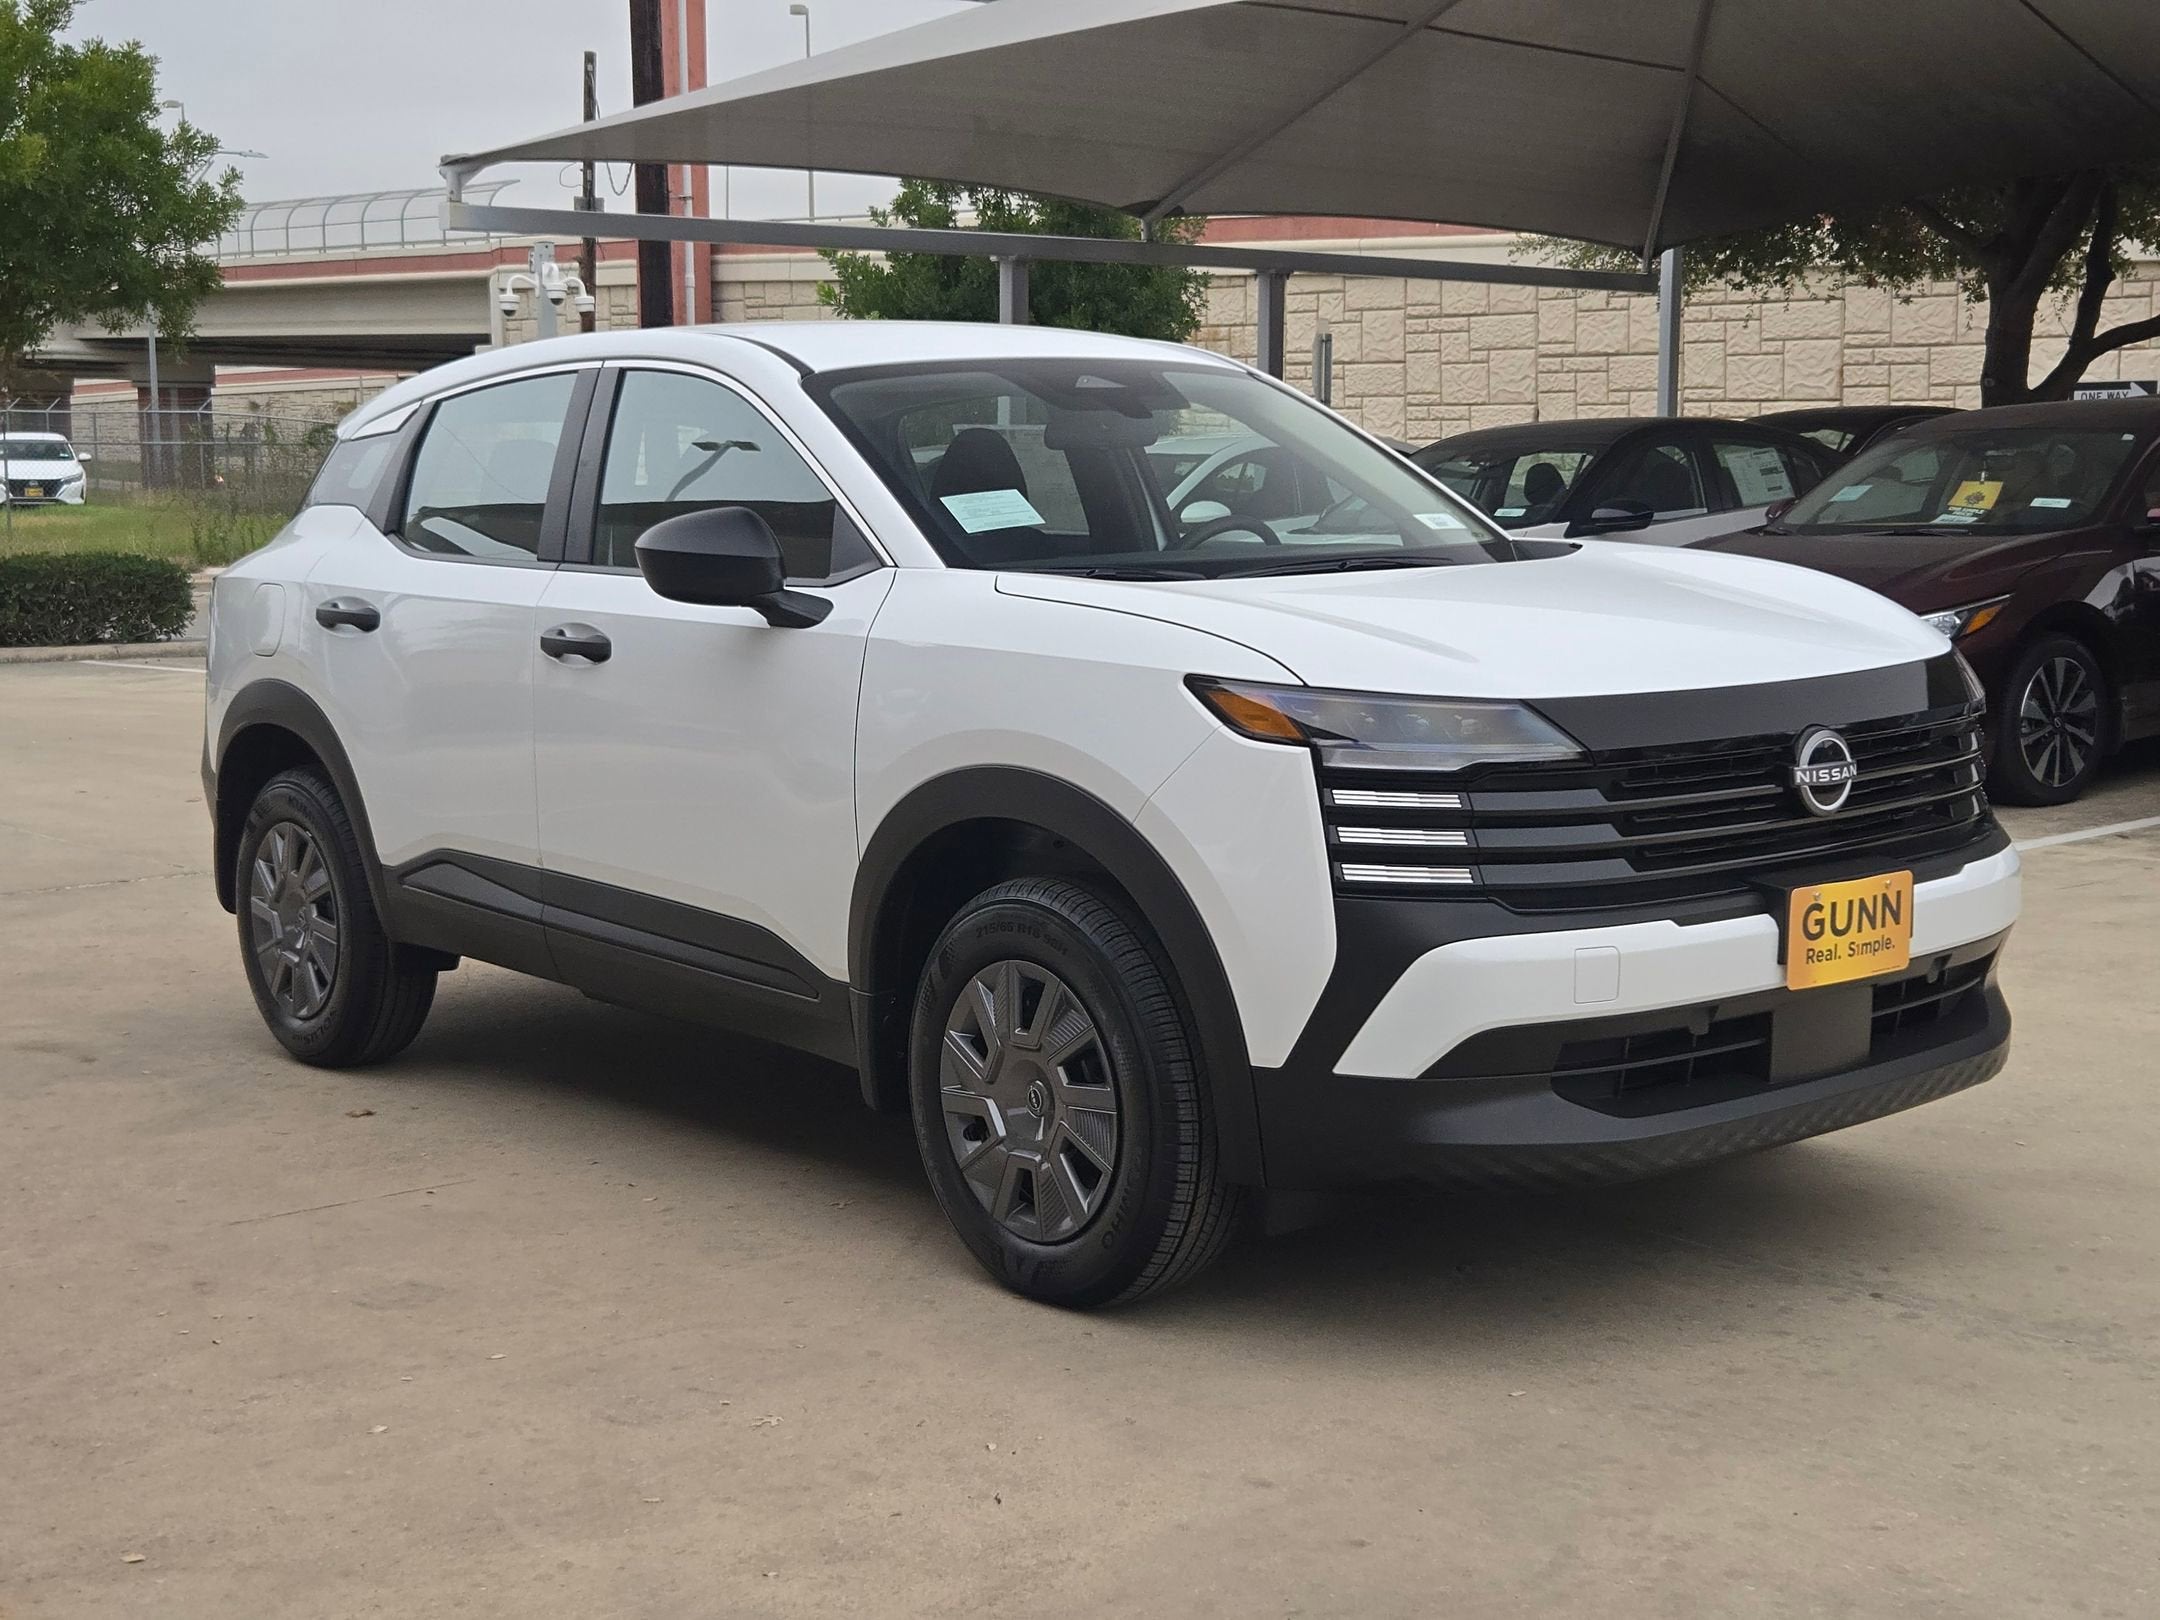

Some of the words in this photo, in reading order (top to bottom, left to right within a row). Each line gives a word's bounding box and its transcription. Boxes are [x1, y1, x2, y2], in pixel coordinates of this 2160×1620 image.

[2080, 391, 2103, 400] ONE
[2107, 391, 2129, 400] WAY
[1796, 763, 1857, 783] NISSAN
[1802, 890, 1902, 941] GUNN
[1805, 943, 1842, 965] Real.
